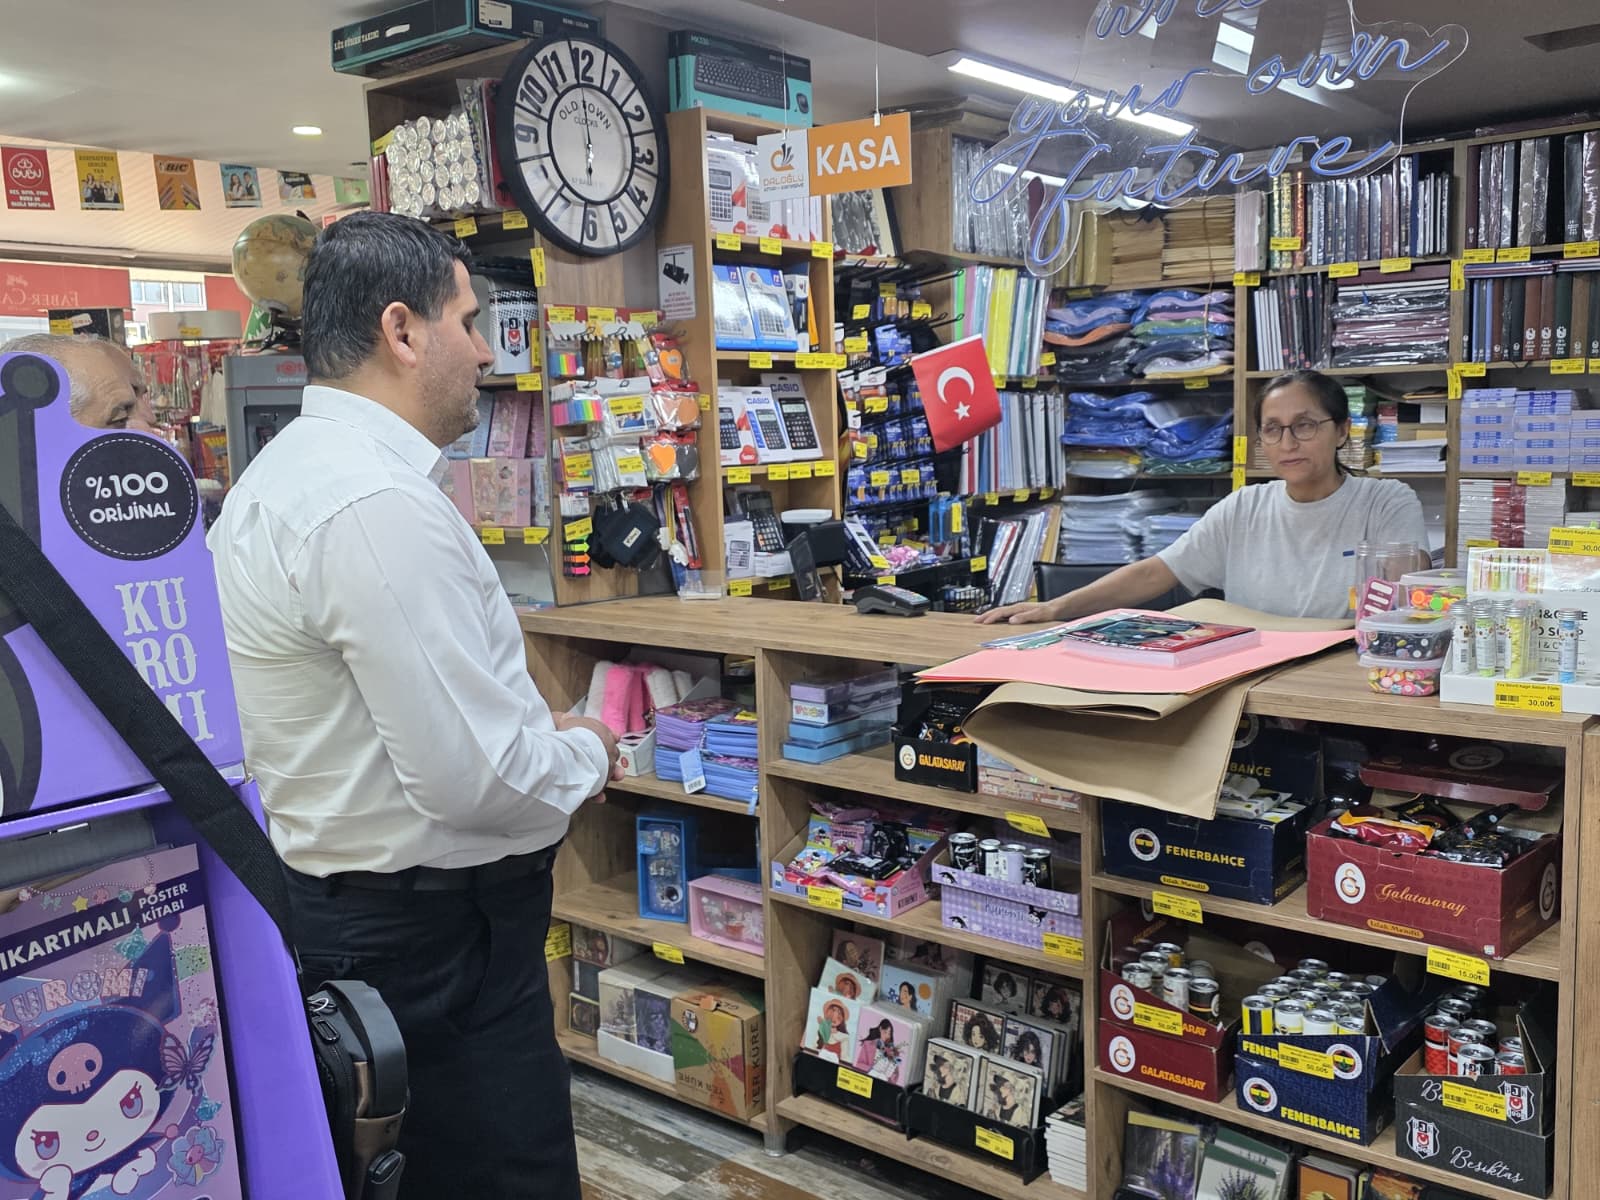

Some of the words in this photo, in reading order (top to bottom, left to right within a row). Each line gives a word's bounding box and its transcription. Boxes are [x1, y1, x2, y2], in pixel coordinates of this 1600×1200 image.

[572, 47, 594, 84] 12
[1247, 32, 1450, 95] own
[520, 74, 548, 114] 10
[606, 69, 620, 94] 1
[559, 100, 578, 120] OLD
[624, 104, 644, 122] 2
[516, 124, 539, 144] 9
[634, 146, 654, 166] 3
[816, 136, 901, 177] KASA
[627, 184, 648, 208] 4
[1032, 126, 1397, 266] future
[585, 209, 598, 242] 6
[611, 203, 628, 234] 5
[770, 384, 800, 392] CASIO
[86, 471, 168, 500] %100
[90, 501, 176, 524] ORİJİNAL
[114, 576, 188, 636] KU
[126, 632, 198, 690] RO
[919, 754, 966, 773] GALATASARAY
[138, 882, 188, 909] POSTER
[1378, 884, 1467, 917] Galatasaray
[141, 899, 185, 924] KİTABI
[1140, 1065, 1206, 1090] GALATASARAY
